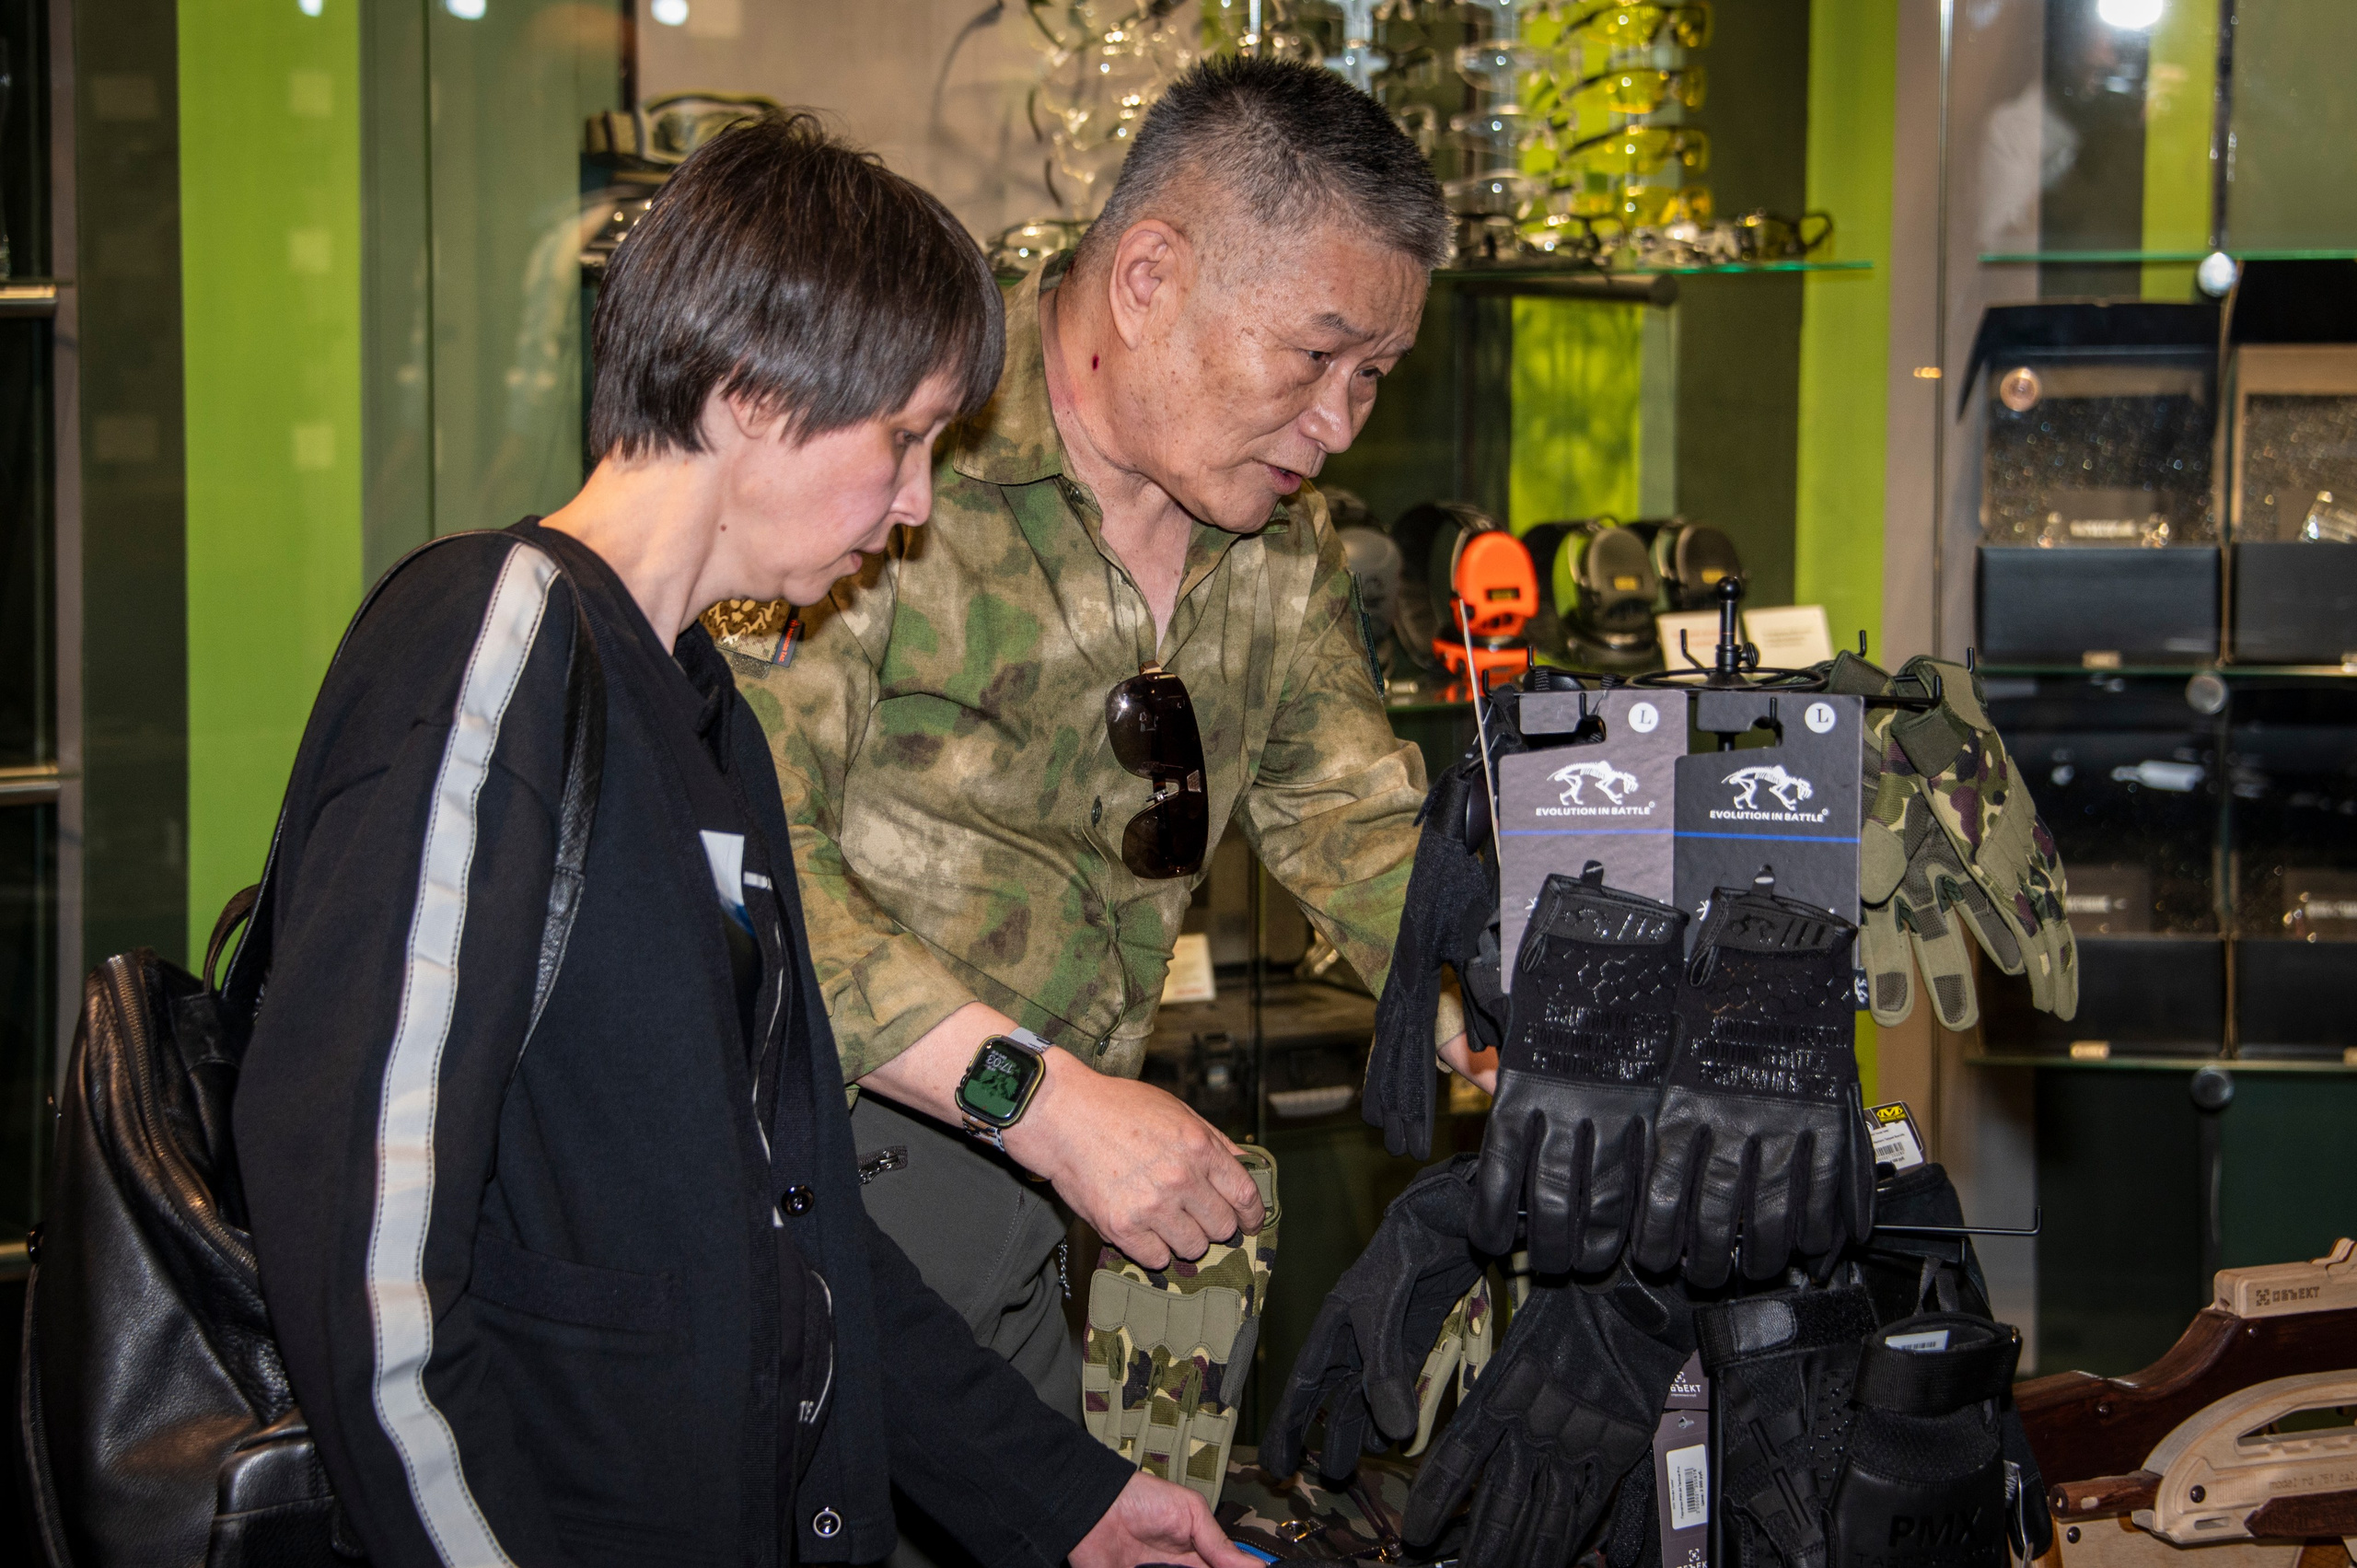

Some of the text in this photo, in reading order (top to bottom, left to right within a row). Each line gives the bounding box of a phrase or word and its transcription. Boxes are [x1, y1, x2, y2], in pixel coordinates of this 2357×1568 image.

[1641, 710, 1652, 725] L
[1817, 708, 1829, 723] L
[1536, 807, 1651, 816] EVOLUTION IN BATTLE
[1710, 810, 1823, 822] EVOLUTION IN BATTLE
[986, 1054, 1013, 1074] 17:03
[2272, 1286, 2320, 1302] ОБЪЕКТ
[1670, 1384, 1701, 1393] БЪЕКТ
[1889, 1505, 1981, 1547] PMX
